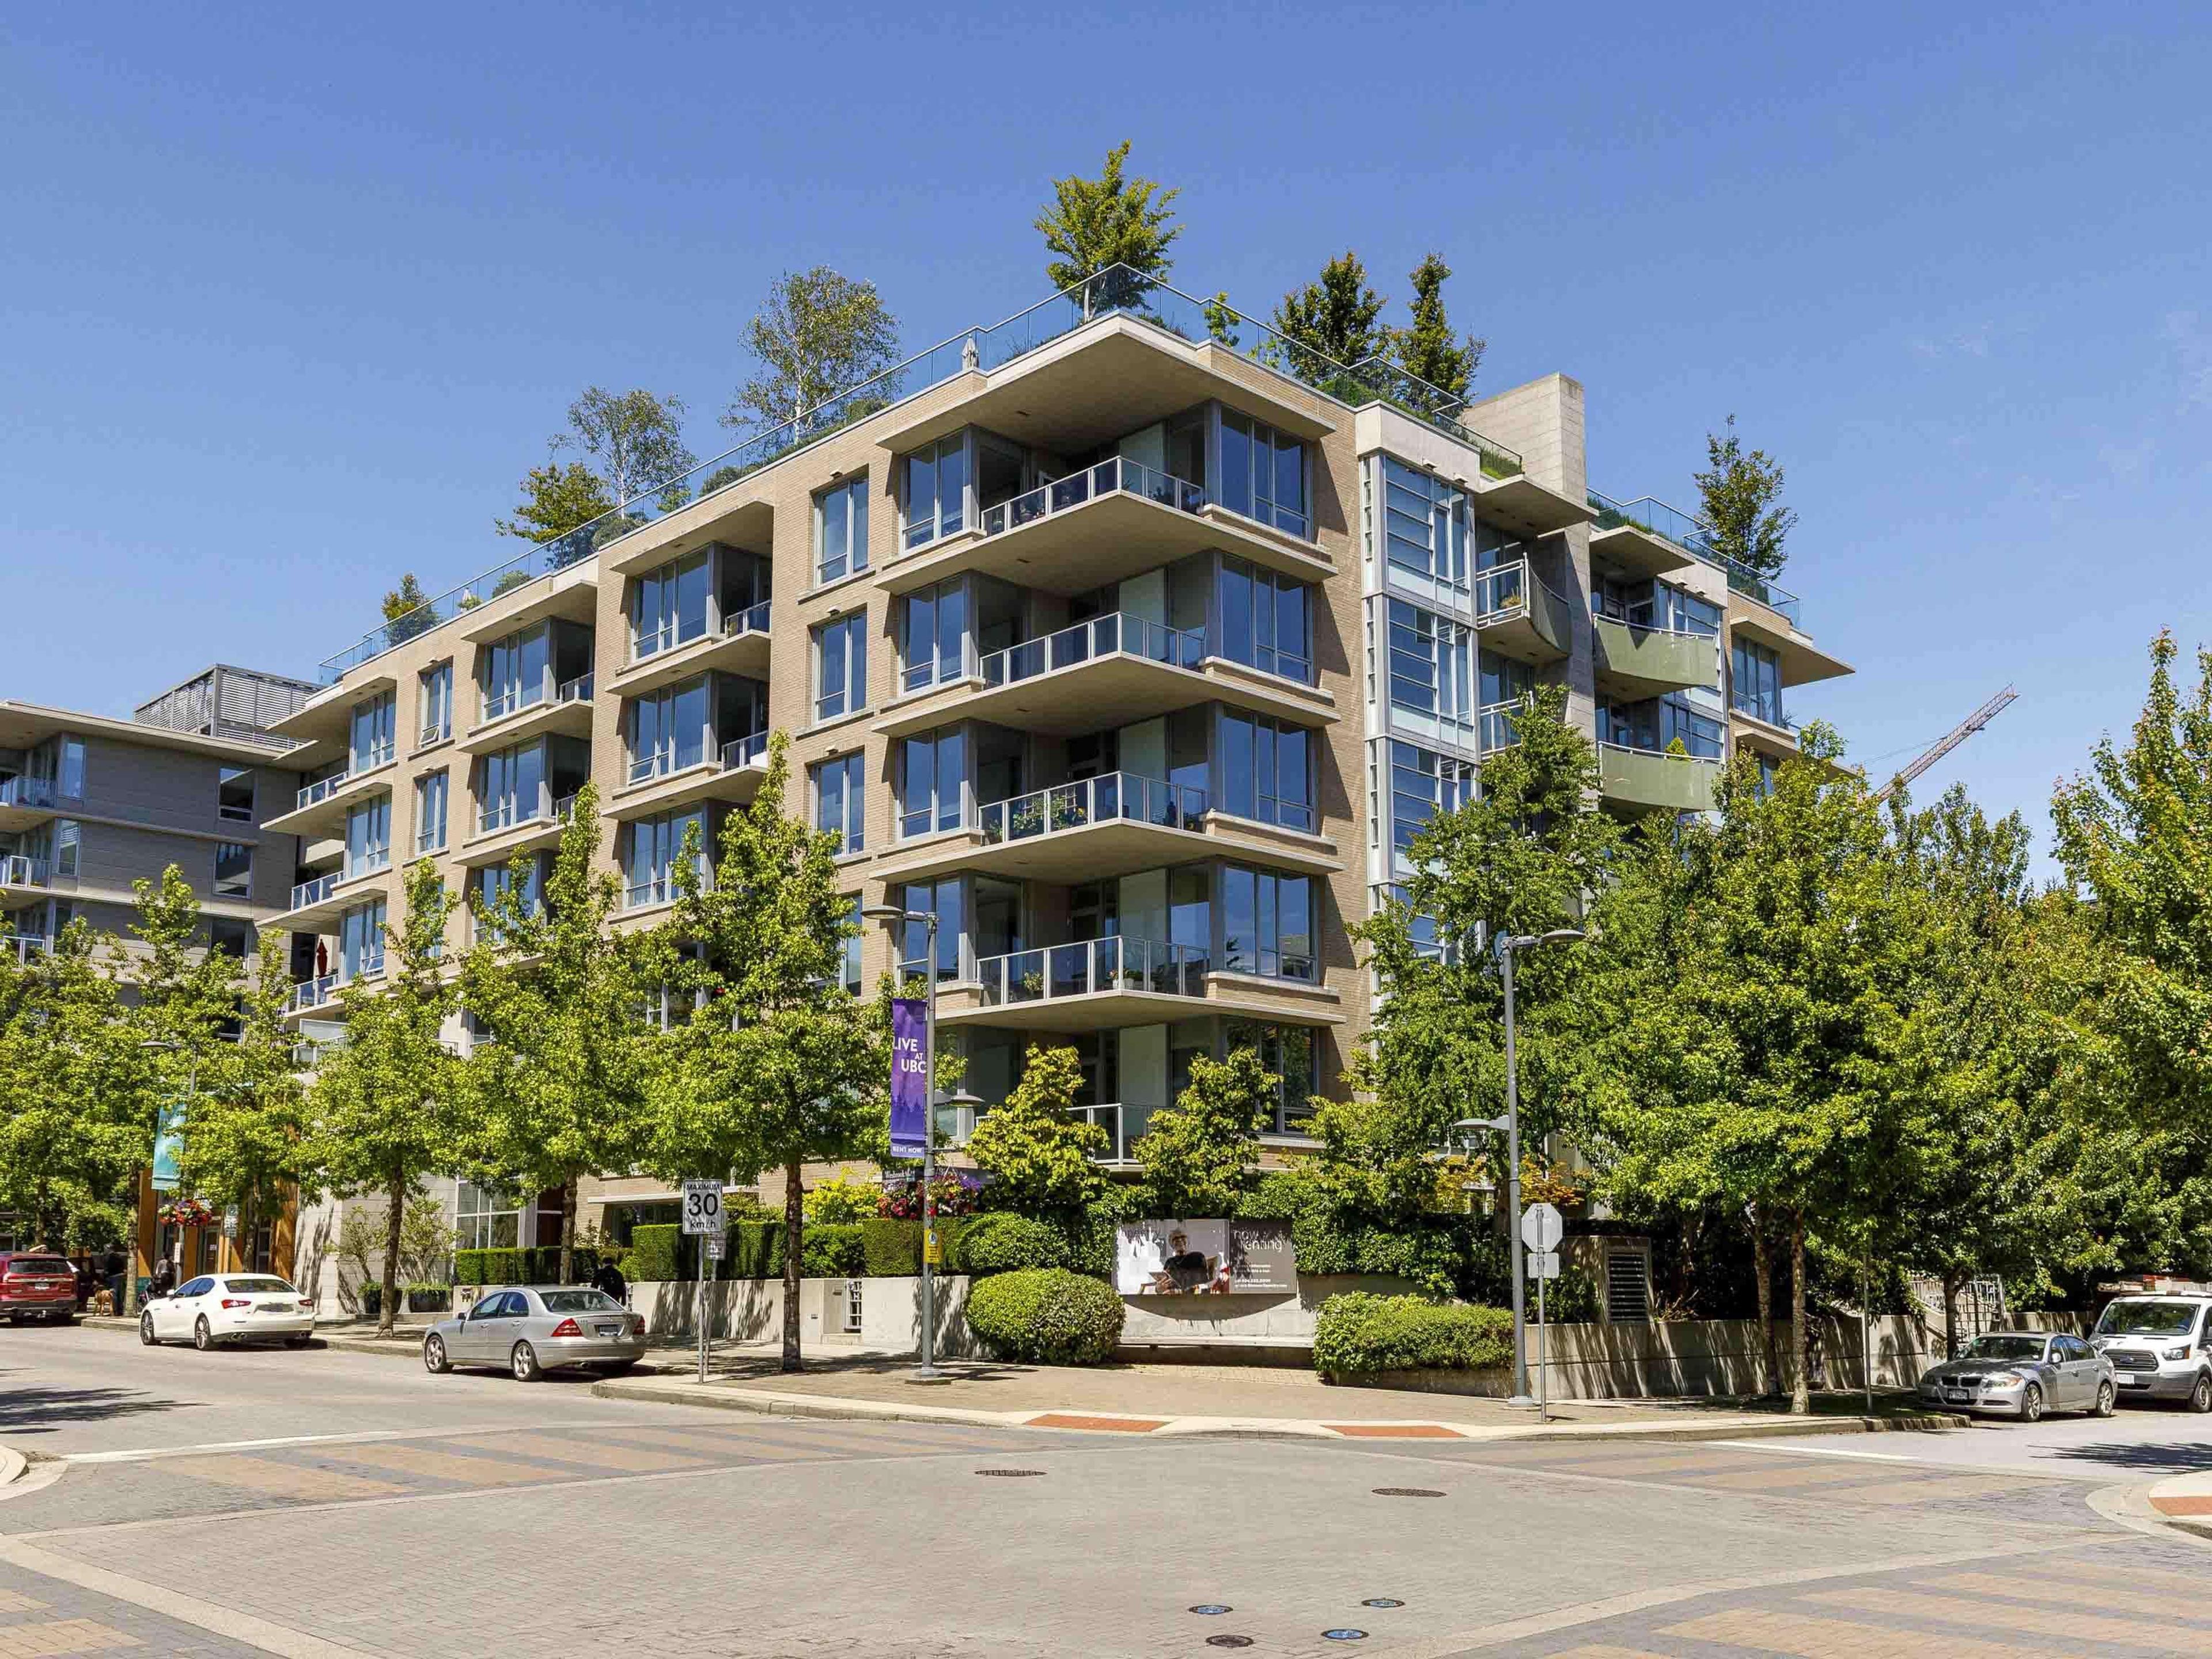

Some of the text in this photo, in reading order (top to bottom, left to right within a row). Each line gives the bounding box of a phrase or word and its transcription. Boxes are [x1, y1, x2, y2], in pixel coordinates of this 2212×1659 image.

[892, 1037, 918, 1052] LIVE
[901, 1058, 927, 1074] UBC
[688, 1192, 718, 1217] 30
[690, 1221, 716, 1229] km/h
[1233, 1229, 1259, 1240] now
[1240, 1238, 1282, 1252] renting
